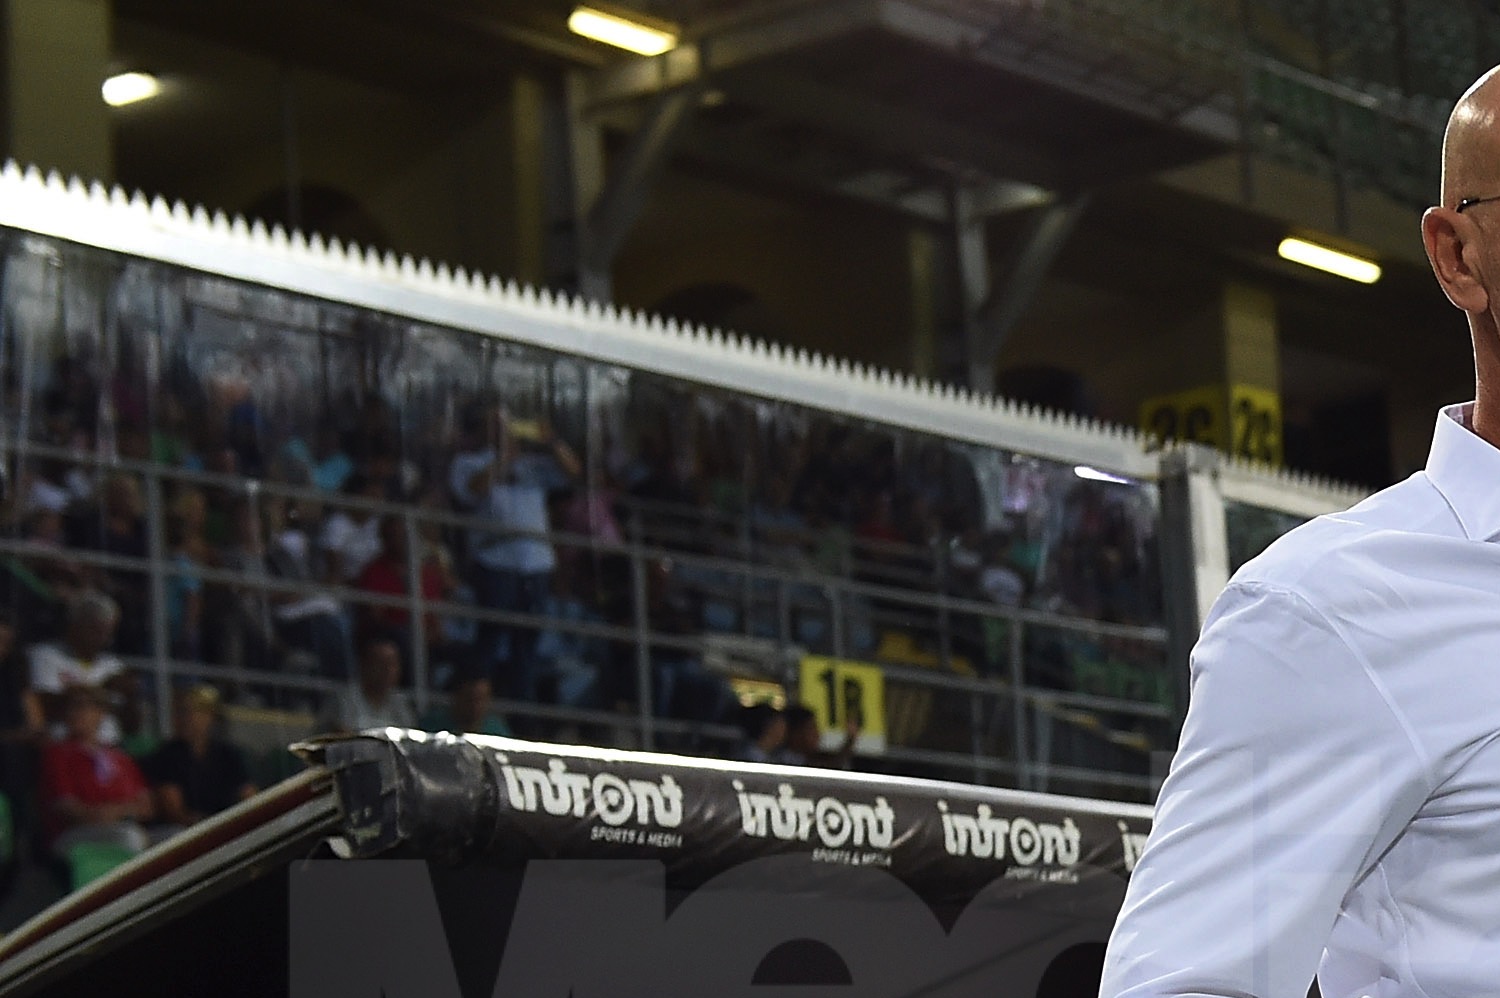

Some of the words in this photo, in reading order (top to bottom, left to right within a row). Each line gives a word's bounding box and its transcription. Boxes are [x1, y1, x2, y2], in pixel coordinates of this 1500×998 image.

[496, 752, 683, 828] infront
[732, 779, 895, 849] infront
[937, 800, 1081, 866] infront
